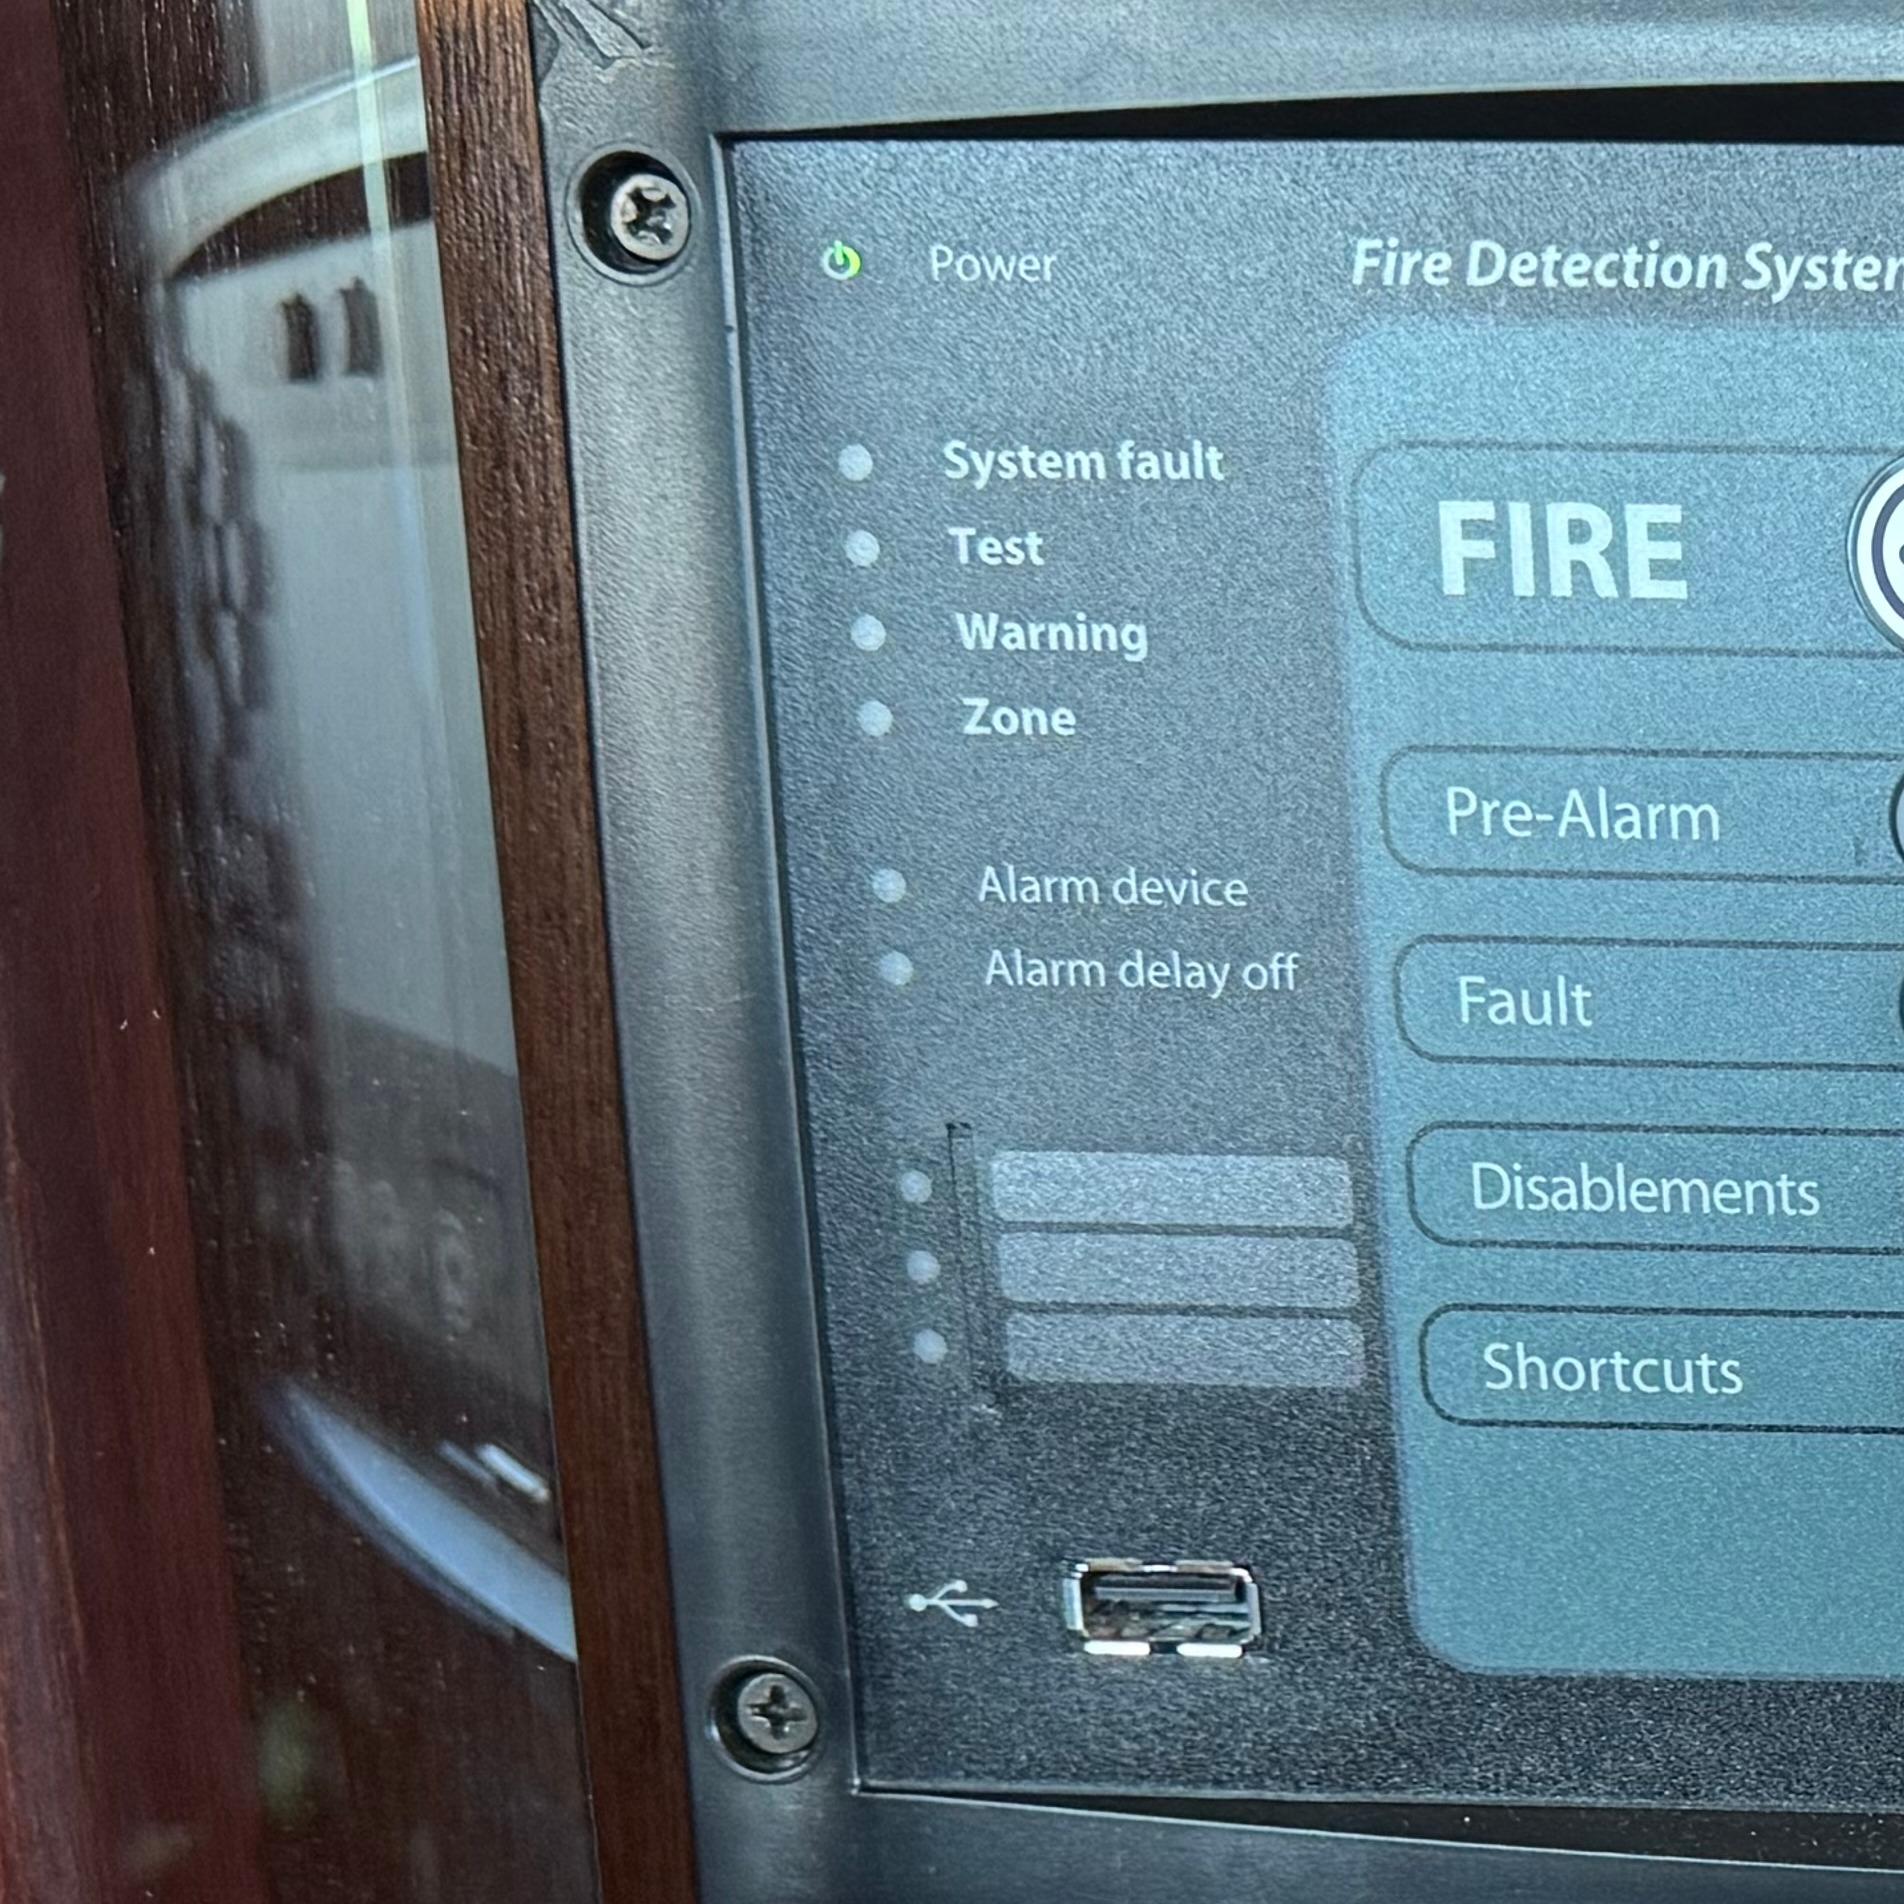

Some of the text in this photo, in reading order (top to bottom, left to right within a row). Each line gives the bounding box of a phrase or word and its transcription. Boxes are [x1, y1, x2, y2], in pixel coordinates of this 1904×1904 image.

[930, 245, 1058, 282] Power
[1352, 238, 1451, 287] Fire
[1467, 239, 1727, 289] Detection
[943, 439, 1225, 490] System fault
[948, 527, 1045, 566] Test
[1438, 500, 1688, 600] FIRE
[955, 612, 1149, 662] Warning
[961, 698, 1077, 736] Zone
[1446, 786, 1721, 841] Pre-Alarm
[978, 864, 1249, 908] Alarm device
[985, 948, 1300, 998] Alarm delay off
[1459, 976, 1593, 1027] Fault
[1472, 1162, 1820, 1218] Disablements
[1484, 1343, 1744, 1396] Shortcuts
